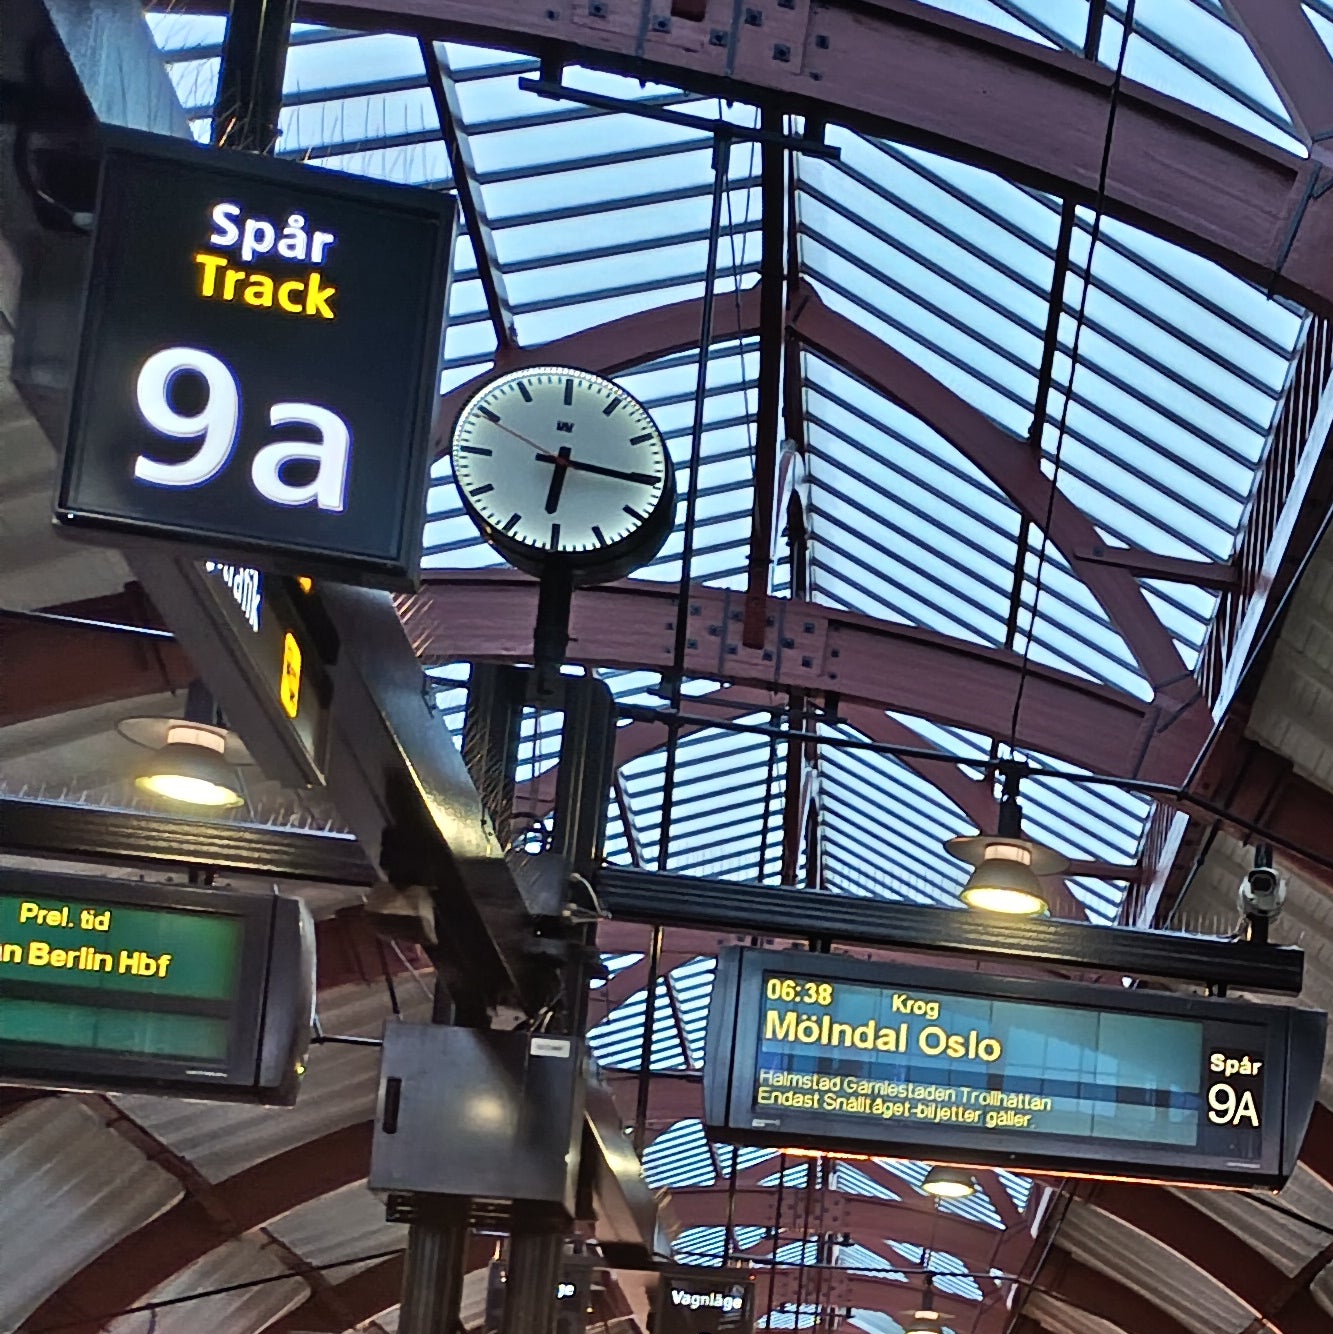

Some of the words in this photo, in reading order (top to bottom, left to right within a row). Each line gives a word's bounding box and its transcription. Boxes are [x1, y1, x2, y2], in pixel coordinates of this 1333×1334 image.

[209, 202, 334, 265] Spår
[195, 252, 336, 319] Track
[134, 346, 352, 513] 9a
[20, 902, 74, 928] Prel.
[80, 909, 111, 932] tid
[28, 941, 113, 972] Berlin
[118, 951, 172, 978] Hbf
[766, 978, 833, 1006] 06:38
[892, 993, 940, 1020] Krog
[764, 1010, 909, 1053] Mölndal
[918, 1025, 1002, 1063] Oslo
[1210, 1053, 1263, 1077] Spår
[757, 1086, 820, 1109] Endast
[759, 1068, 841, 1092] Halmstad
[960, 1086, 1053, 1112] Trollhättan
[1208, 1083, 1260, 1127] 9A
[671, 1289, 743, 1312] Vagnläge
